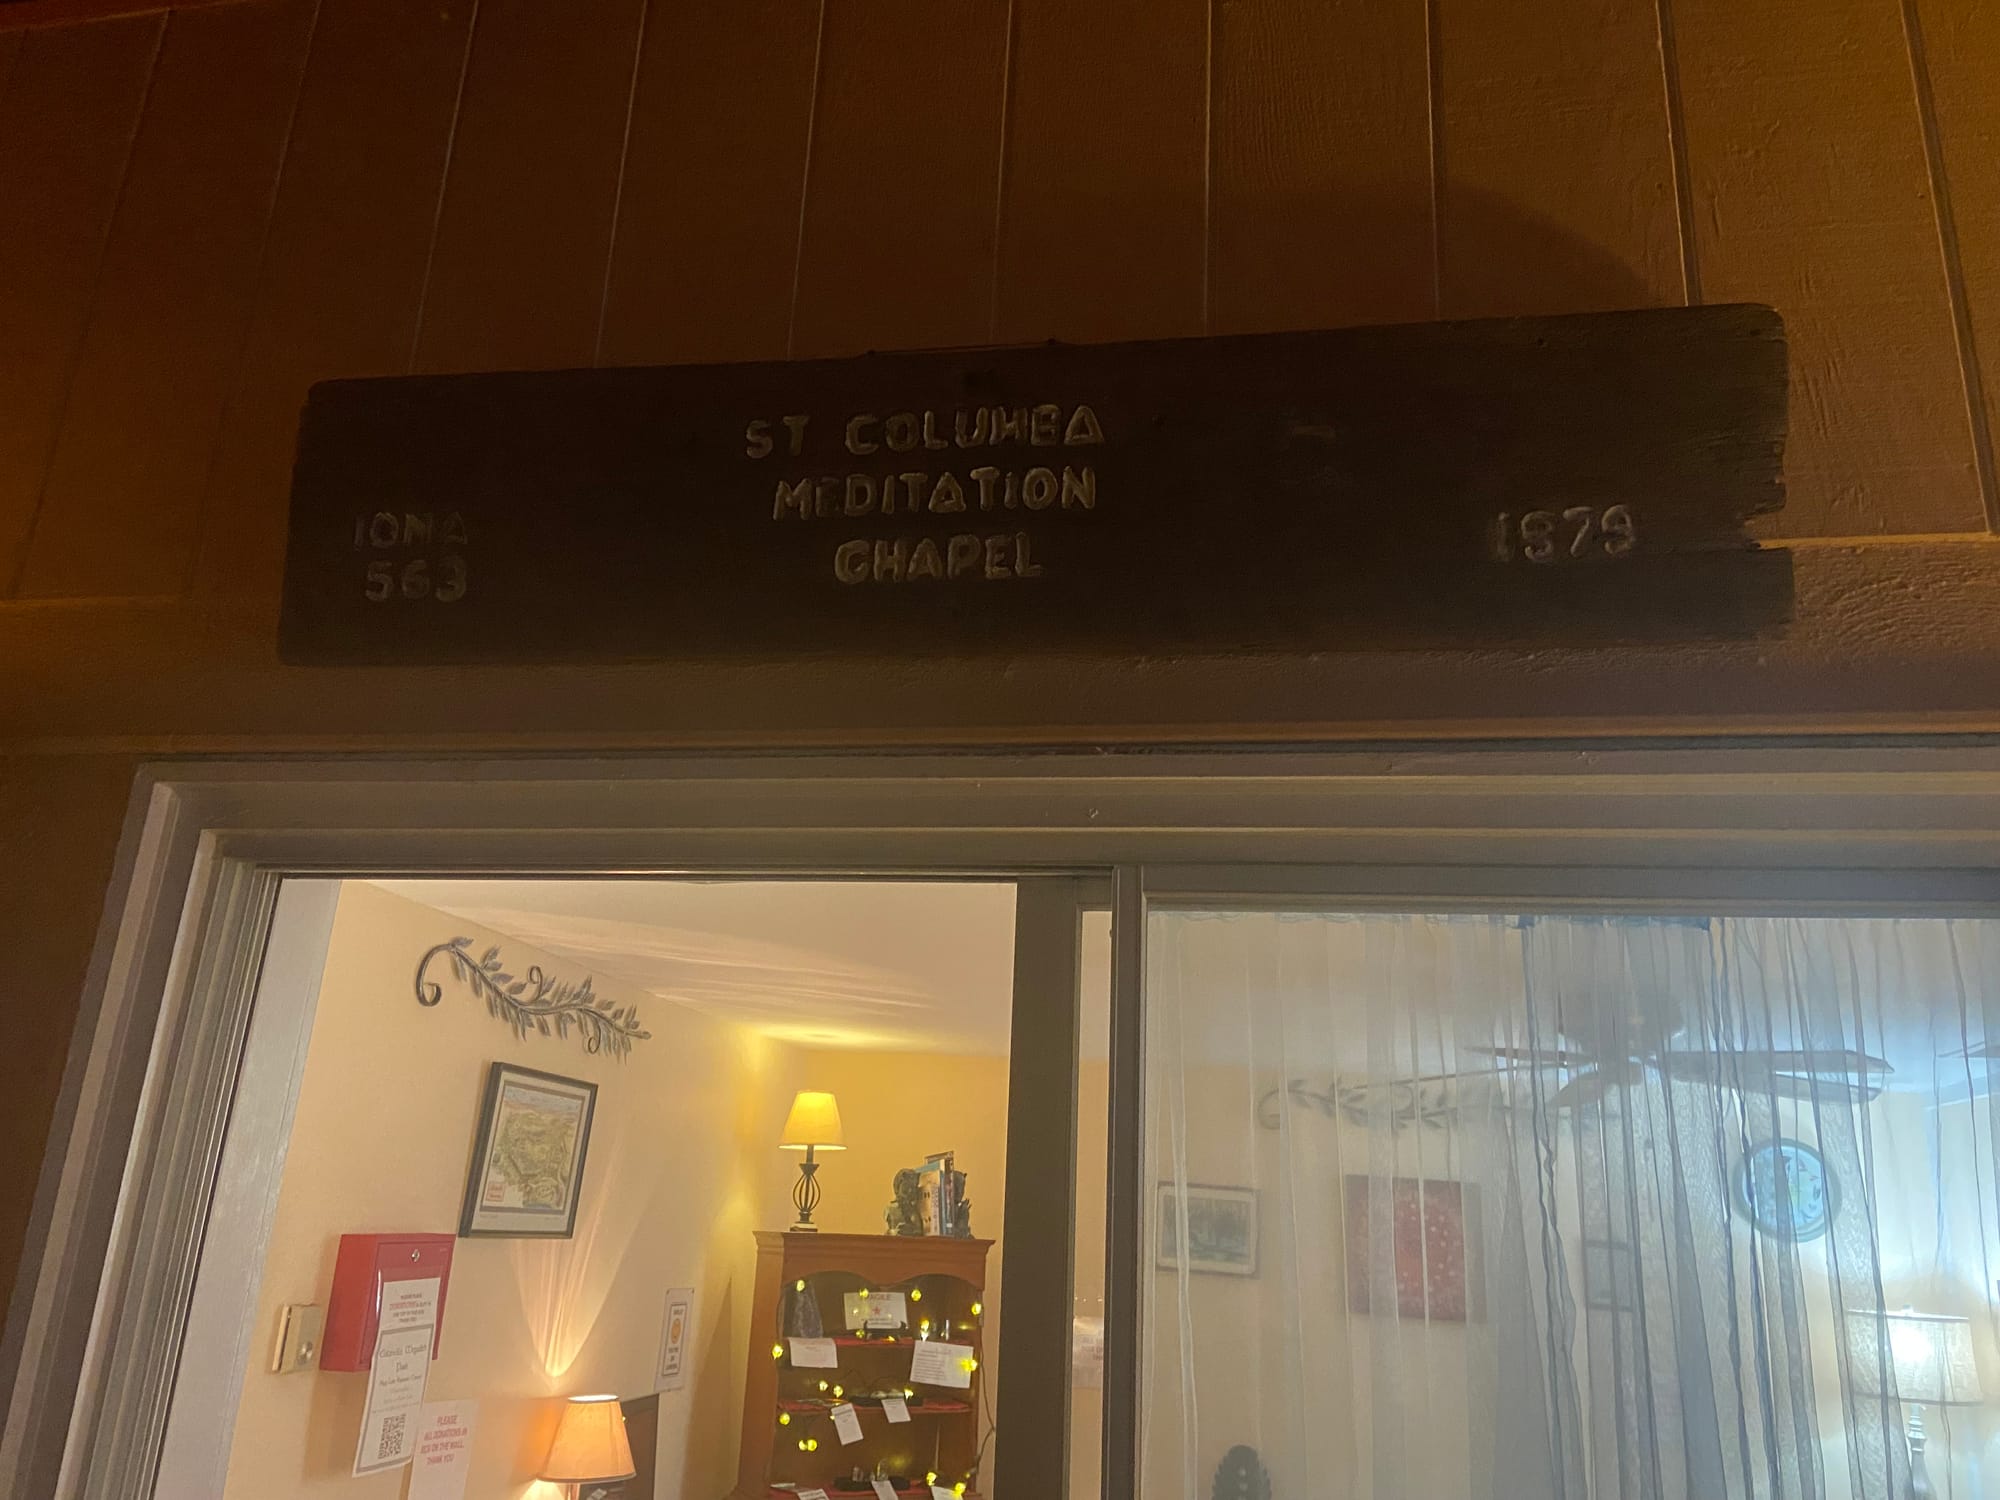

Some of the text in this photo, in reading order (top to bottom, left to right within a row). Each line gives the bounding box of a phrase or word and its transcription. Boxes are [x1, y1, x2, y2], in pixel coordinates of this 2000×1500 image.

[745, 403, 1104, 459] ST COLUMBA
[772, 466, 1097, 521] MEDITATION
[354, 511, 468, 547] IONA
[364, 555, 467, 602] 563
[834, 531, 1043, 585] CHAPEL
